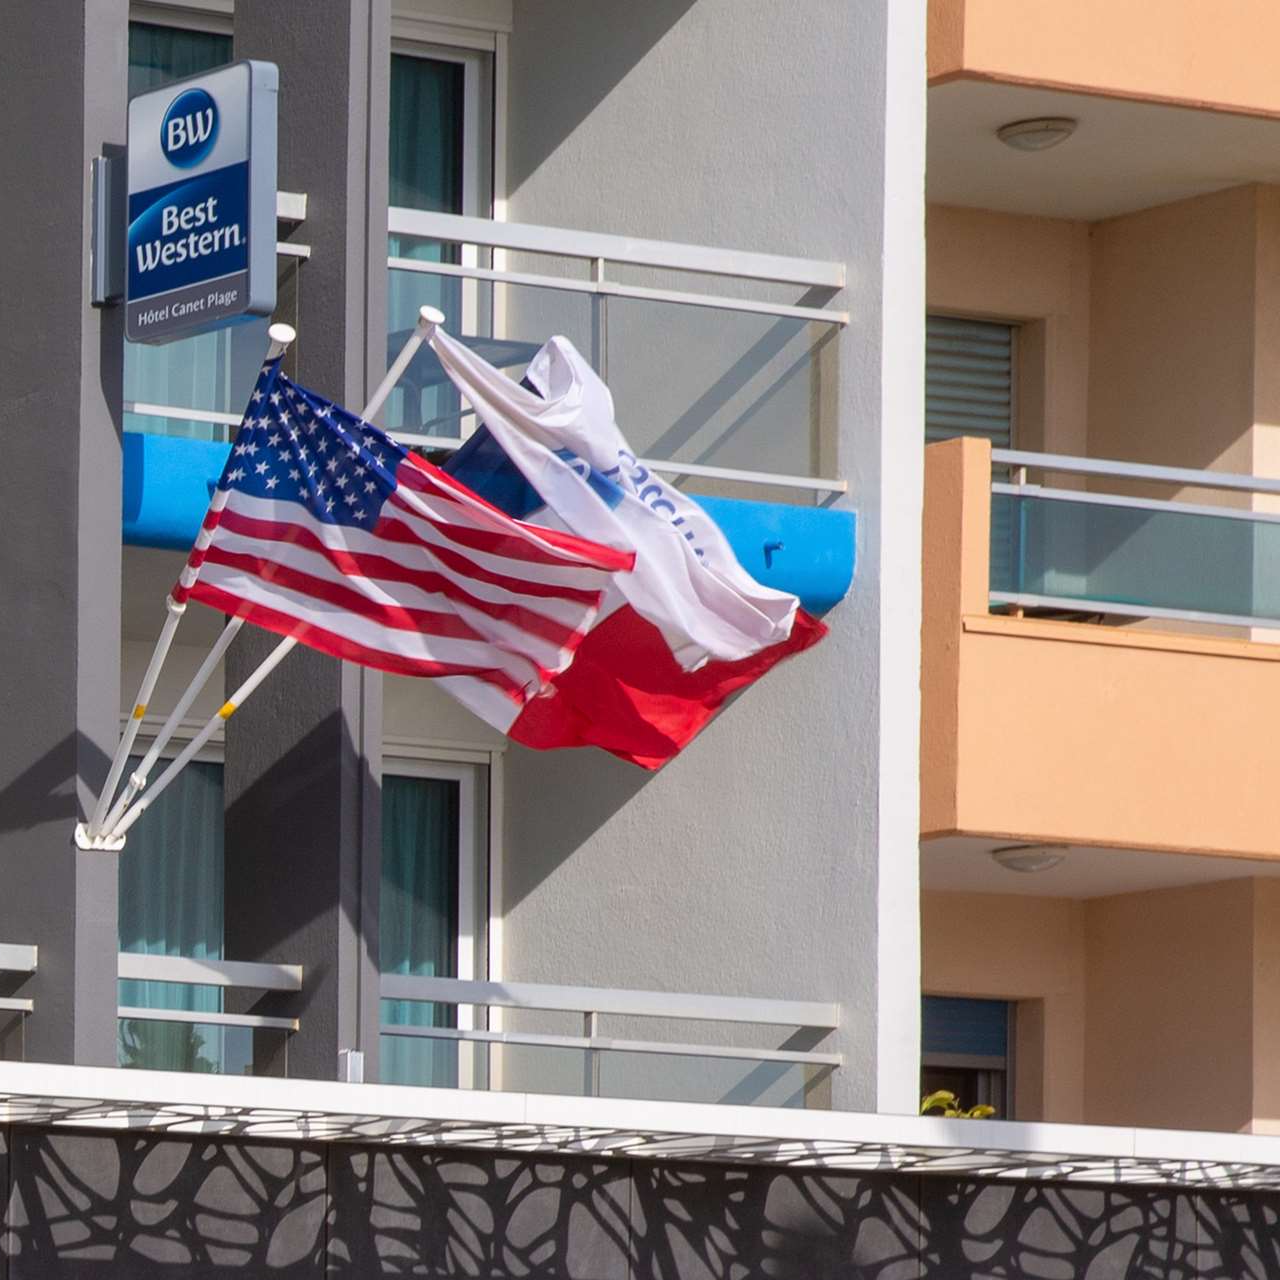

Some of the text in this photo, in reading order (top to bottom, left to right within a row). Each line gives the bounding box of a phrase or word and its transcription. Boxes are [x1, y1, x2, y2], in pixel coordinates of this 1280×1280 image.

[166, 108, 214, 152] BW
[161, 196, 218, 236] Best
[135, 223, 242, 274] Western
[138, 288, 238, 327] Hôtel Canet Plage
